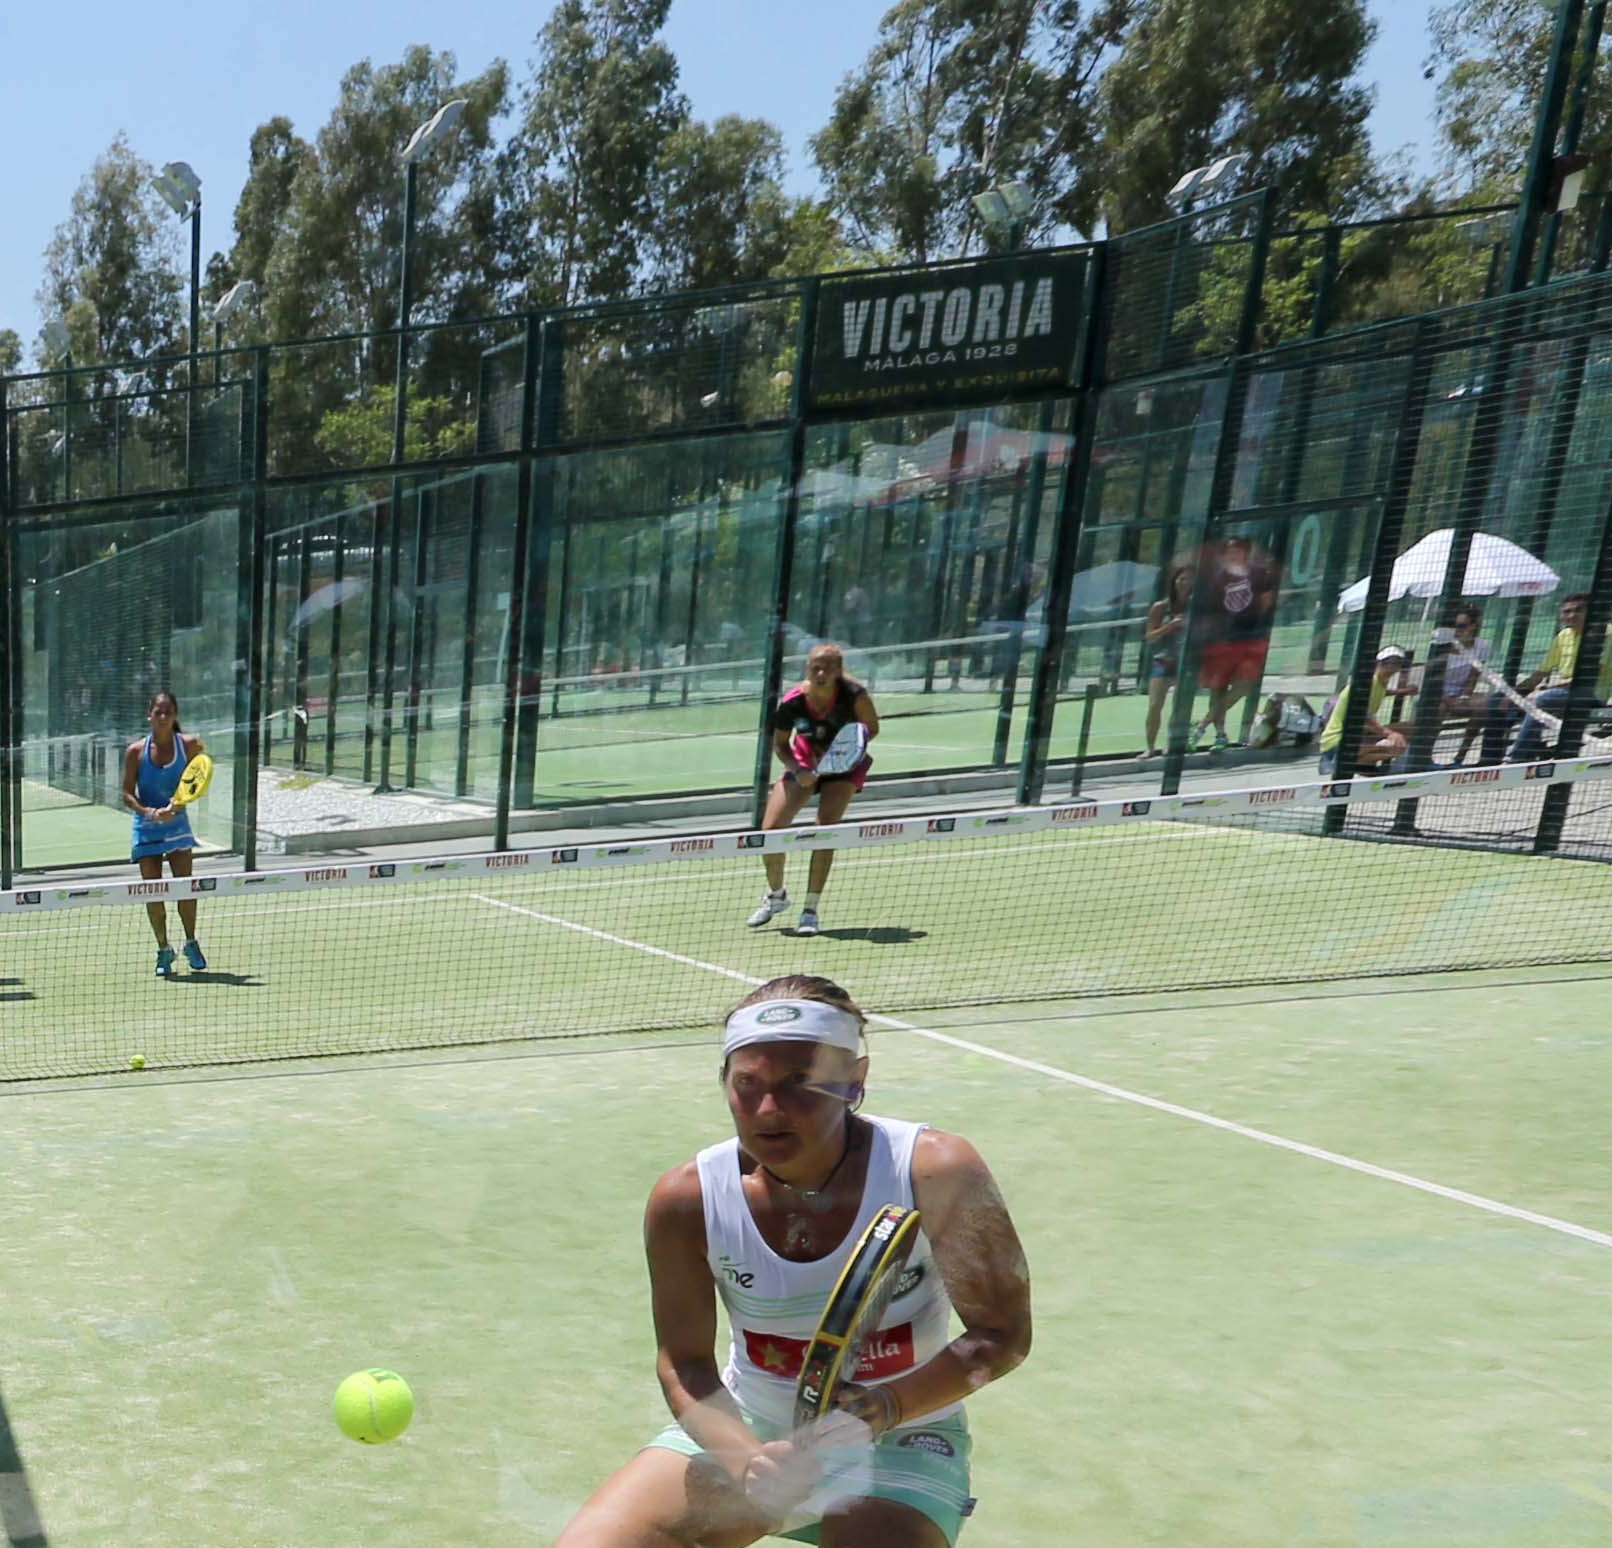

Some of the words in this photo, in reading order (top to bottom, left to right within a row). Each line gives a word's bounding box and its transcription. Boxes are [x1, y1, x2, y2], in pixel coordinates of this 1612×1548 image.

[842, 276, 1054, 359] VICTORIA
[964, 342, 1019, 361] 1928
[127, 881, 170, 896] VICTORIA
